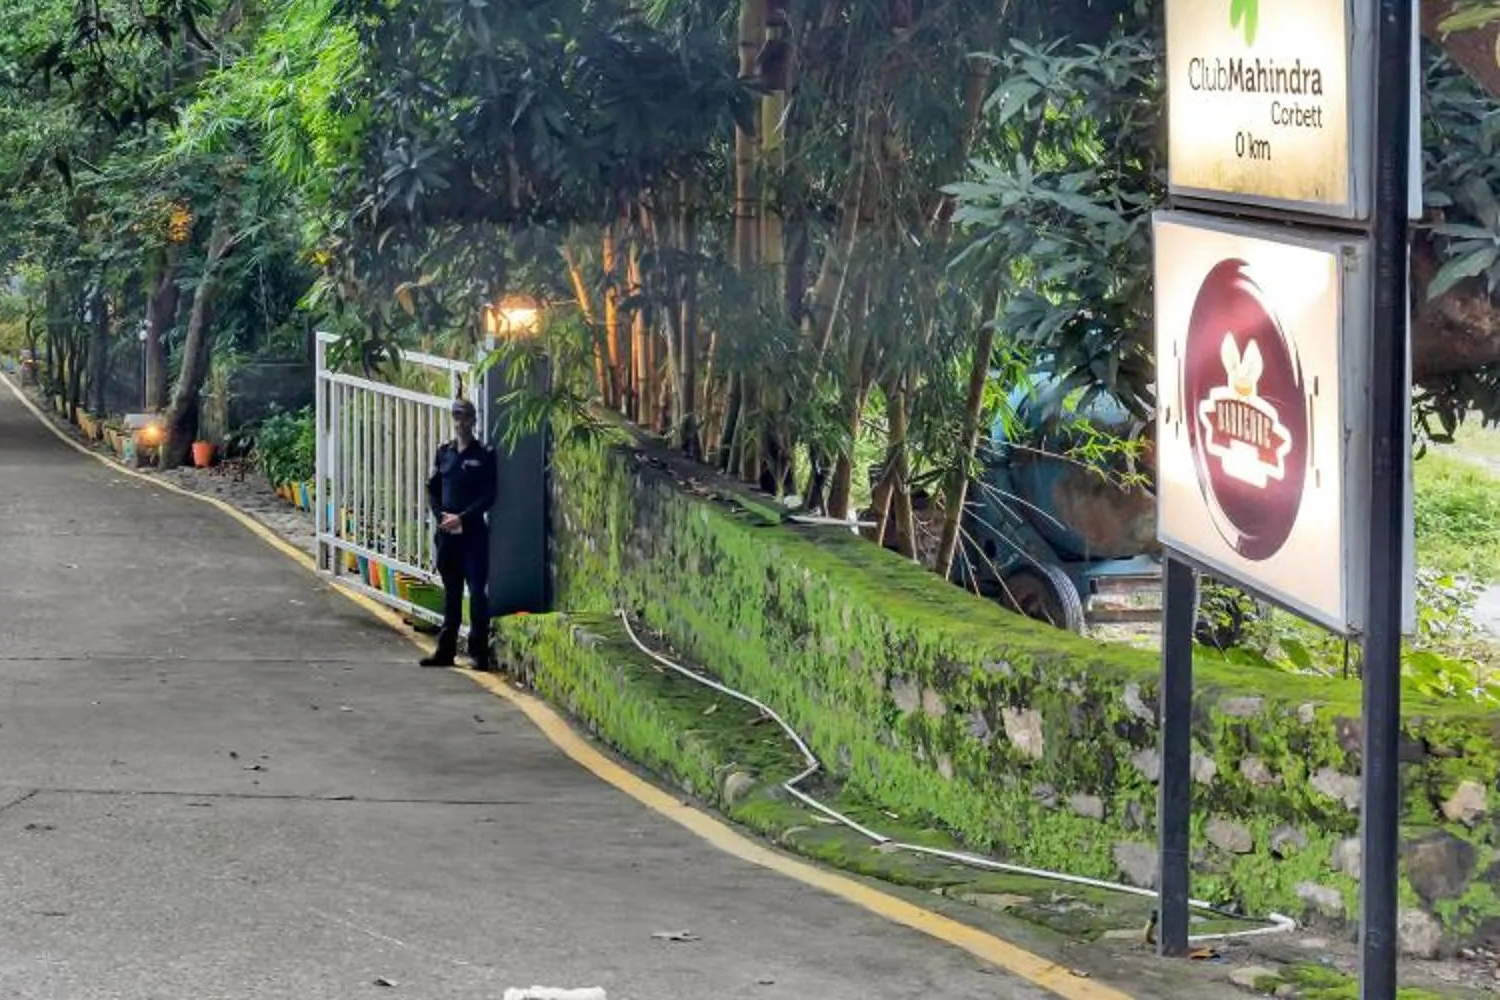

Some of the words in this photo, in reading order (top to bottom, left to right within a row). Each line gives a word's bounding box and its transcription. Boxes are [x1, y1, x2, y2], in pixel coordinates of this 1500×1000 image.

[1188, 57, 1323, 96] ClubMahindra
[1271, 101, 1323, 128] Corbett
[1235, 131, 1245, 158] 0
[1248, 131, 1271, 161] km
